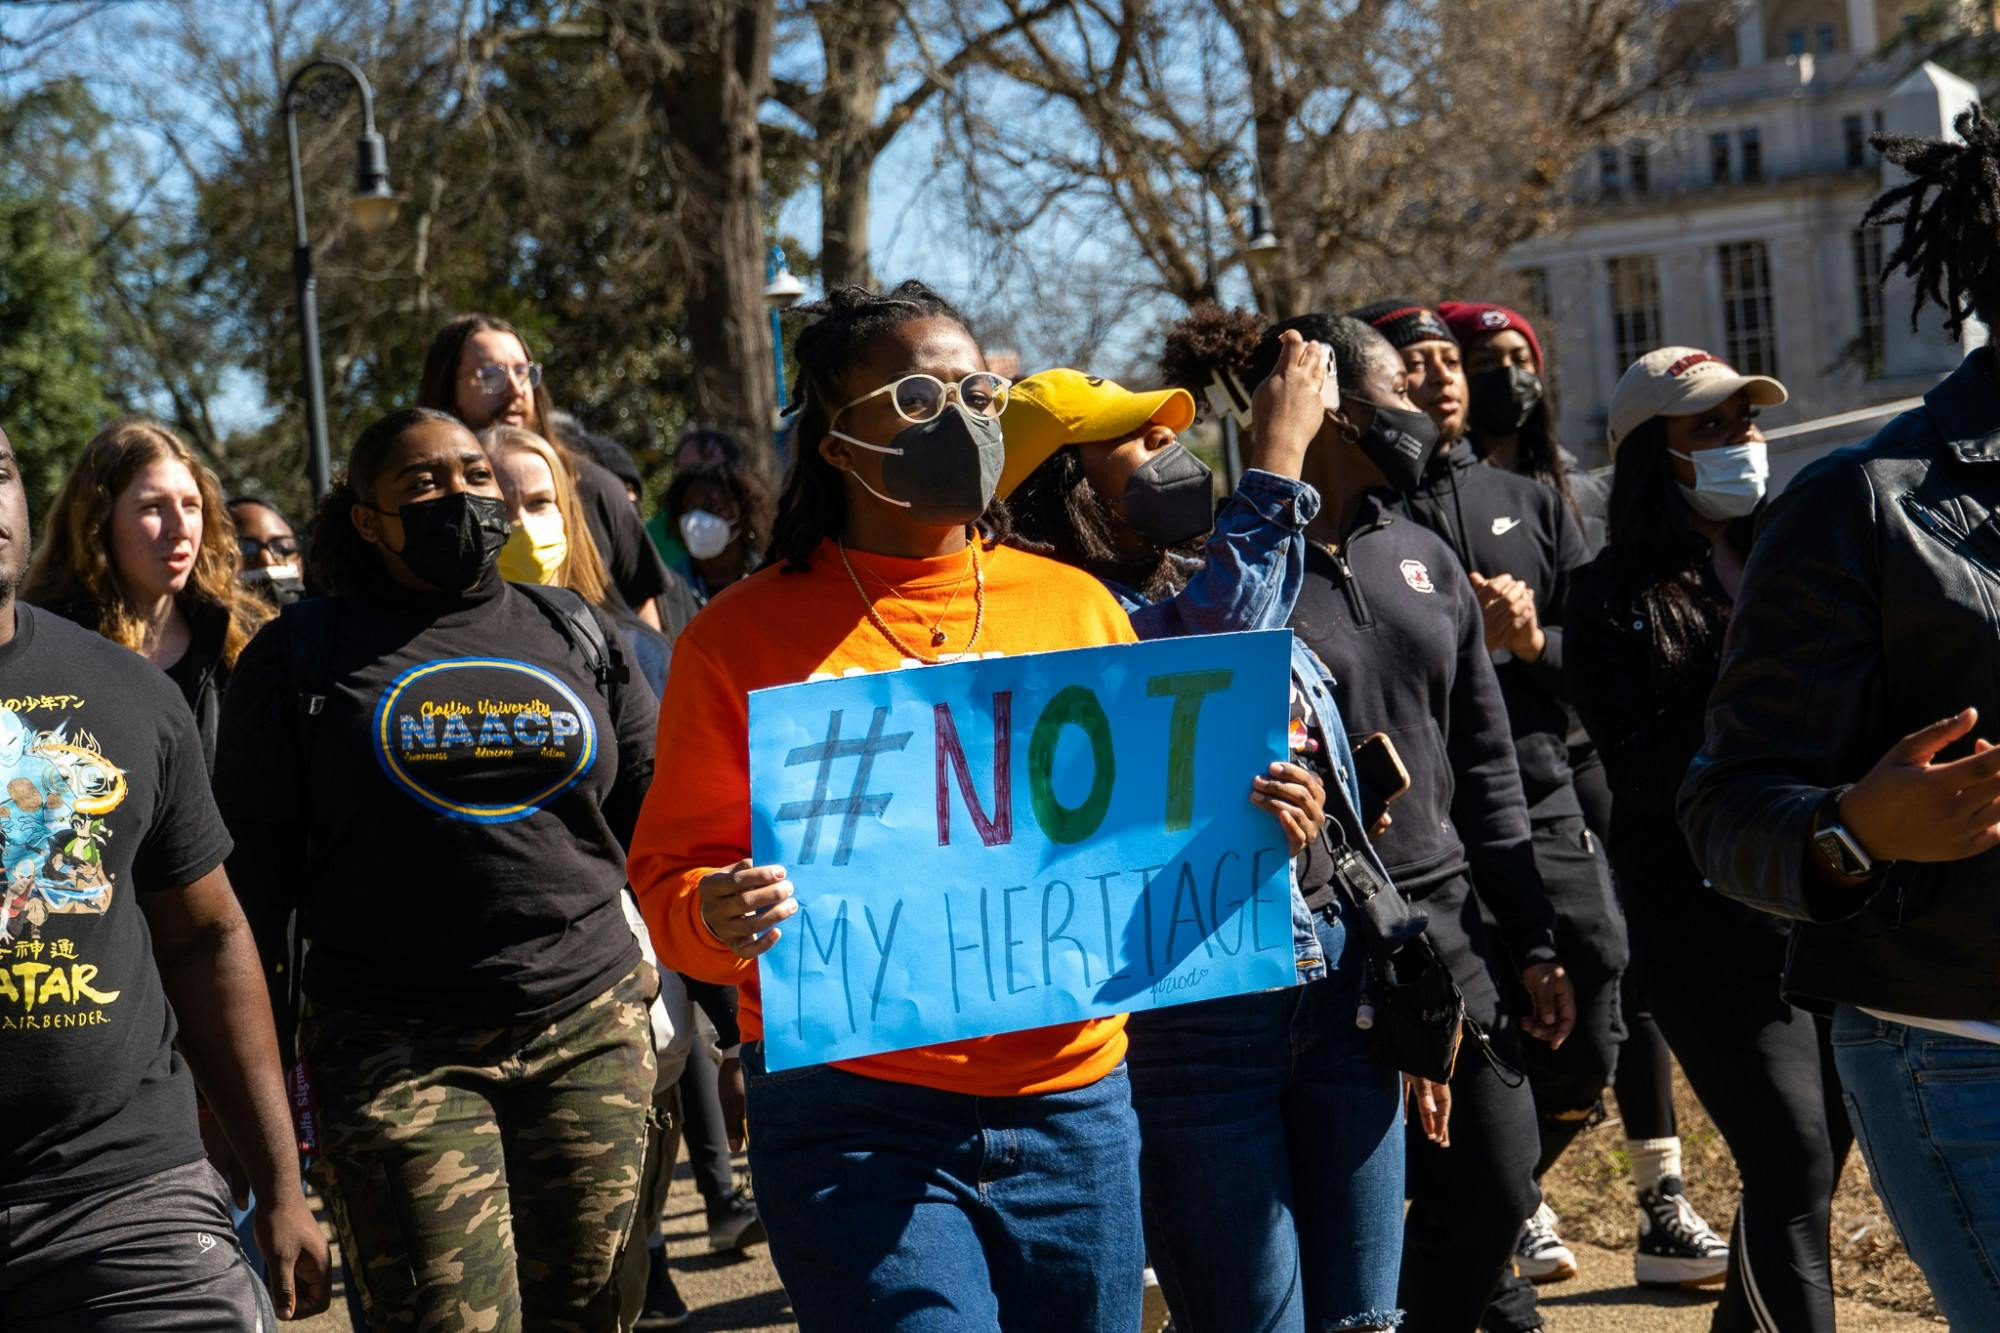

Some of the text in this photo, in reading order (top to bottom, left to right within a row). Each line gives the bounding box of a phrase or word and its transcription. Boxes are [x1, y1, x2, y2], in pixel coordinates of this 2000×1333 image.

[0, 694, 86, 714] の少年アン
[420, 698, 552, 719] Claflin University
[400, 710, 581, 750] NAACP
[474, 747, 514, 759] Advocacy
[797, 846, 1284, 1041] MY HERITAGE
[295, 1062, 310, 1107] Sigma
